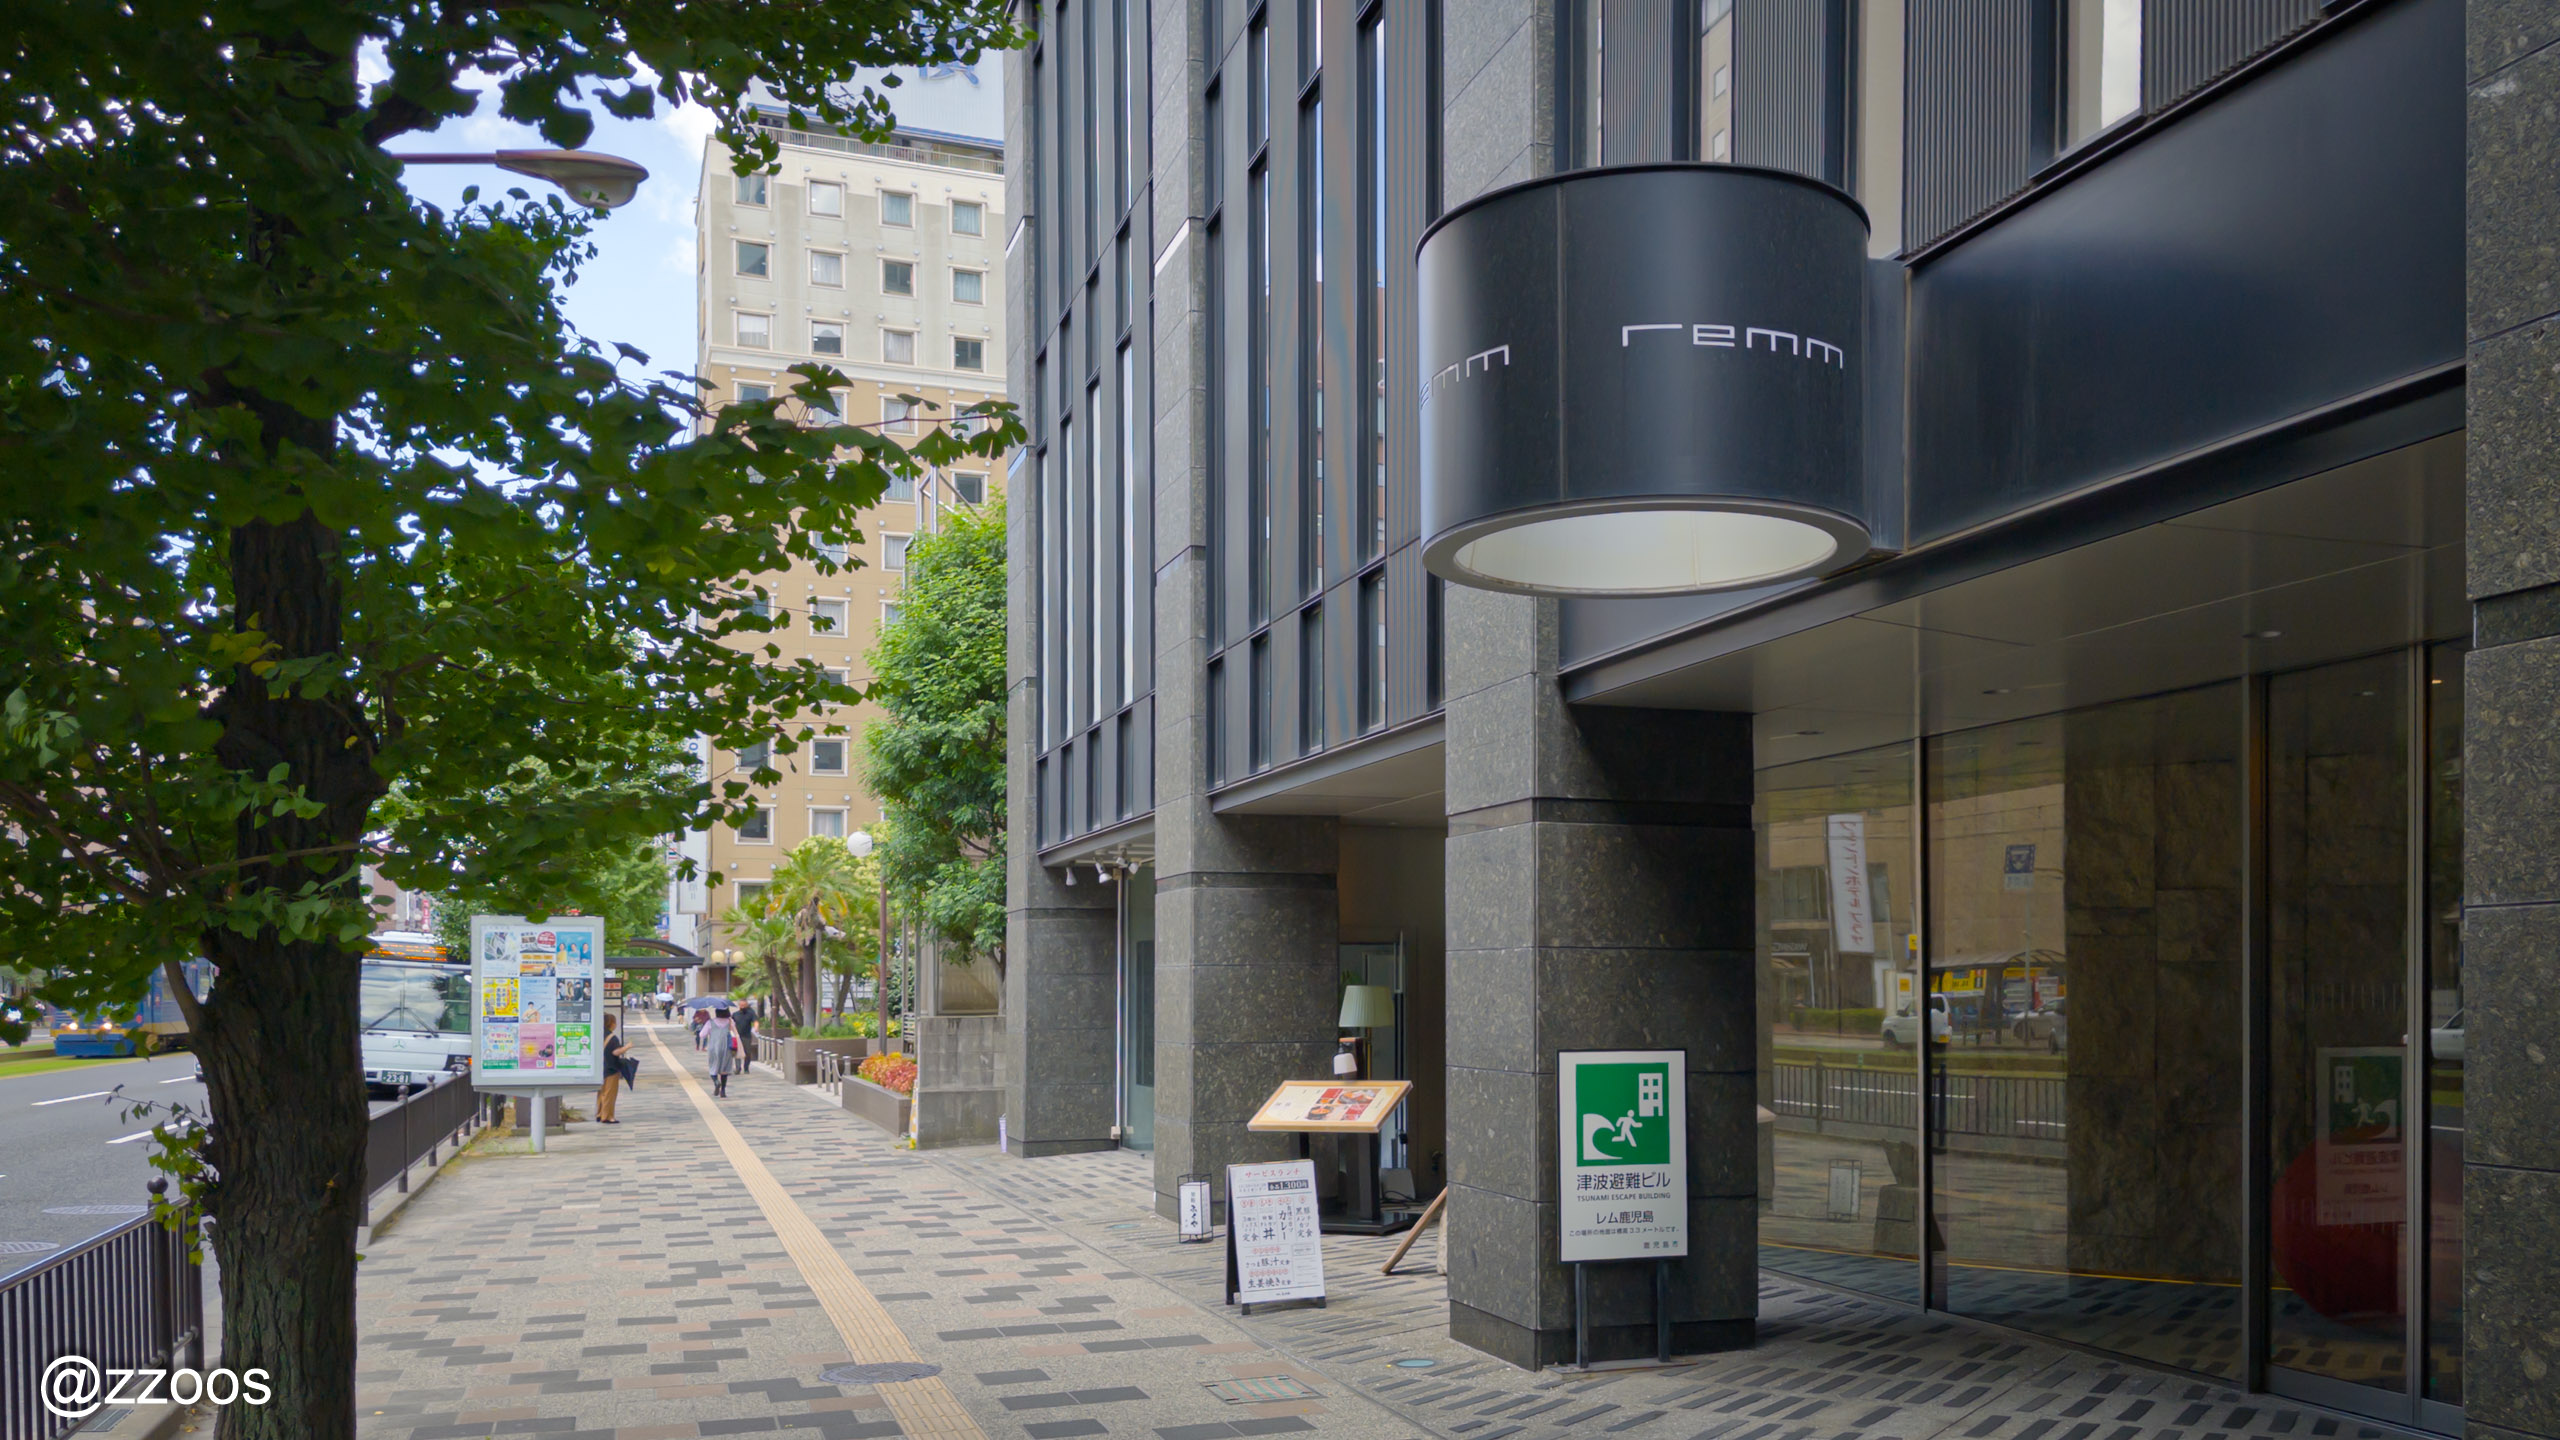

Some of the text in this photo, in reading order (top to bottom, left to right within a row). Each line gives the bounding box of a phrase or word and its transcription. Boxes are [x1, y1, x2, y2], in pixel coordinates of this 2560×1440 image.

[1621, 323, 1844, 369] remm
[1420, 344, 1510, 410] emm
[1245, 1168, 1301, 1179] サービスランチ
[1576, 1172, 1671, 1191] 津波避難ビル
[1638, 1192, 1671, 1200] BUILDING
[1278, 1210, 1288, 1240] カレー
[1596, 1211, 1654, 1225] レム鹿児島
[1263, 1227, 1276, 1240] 丼
